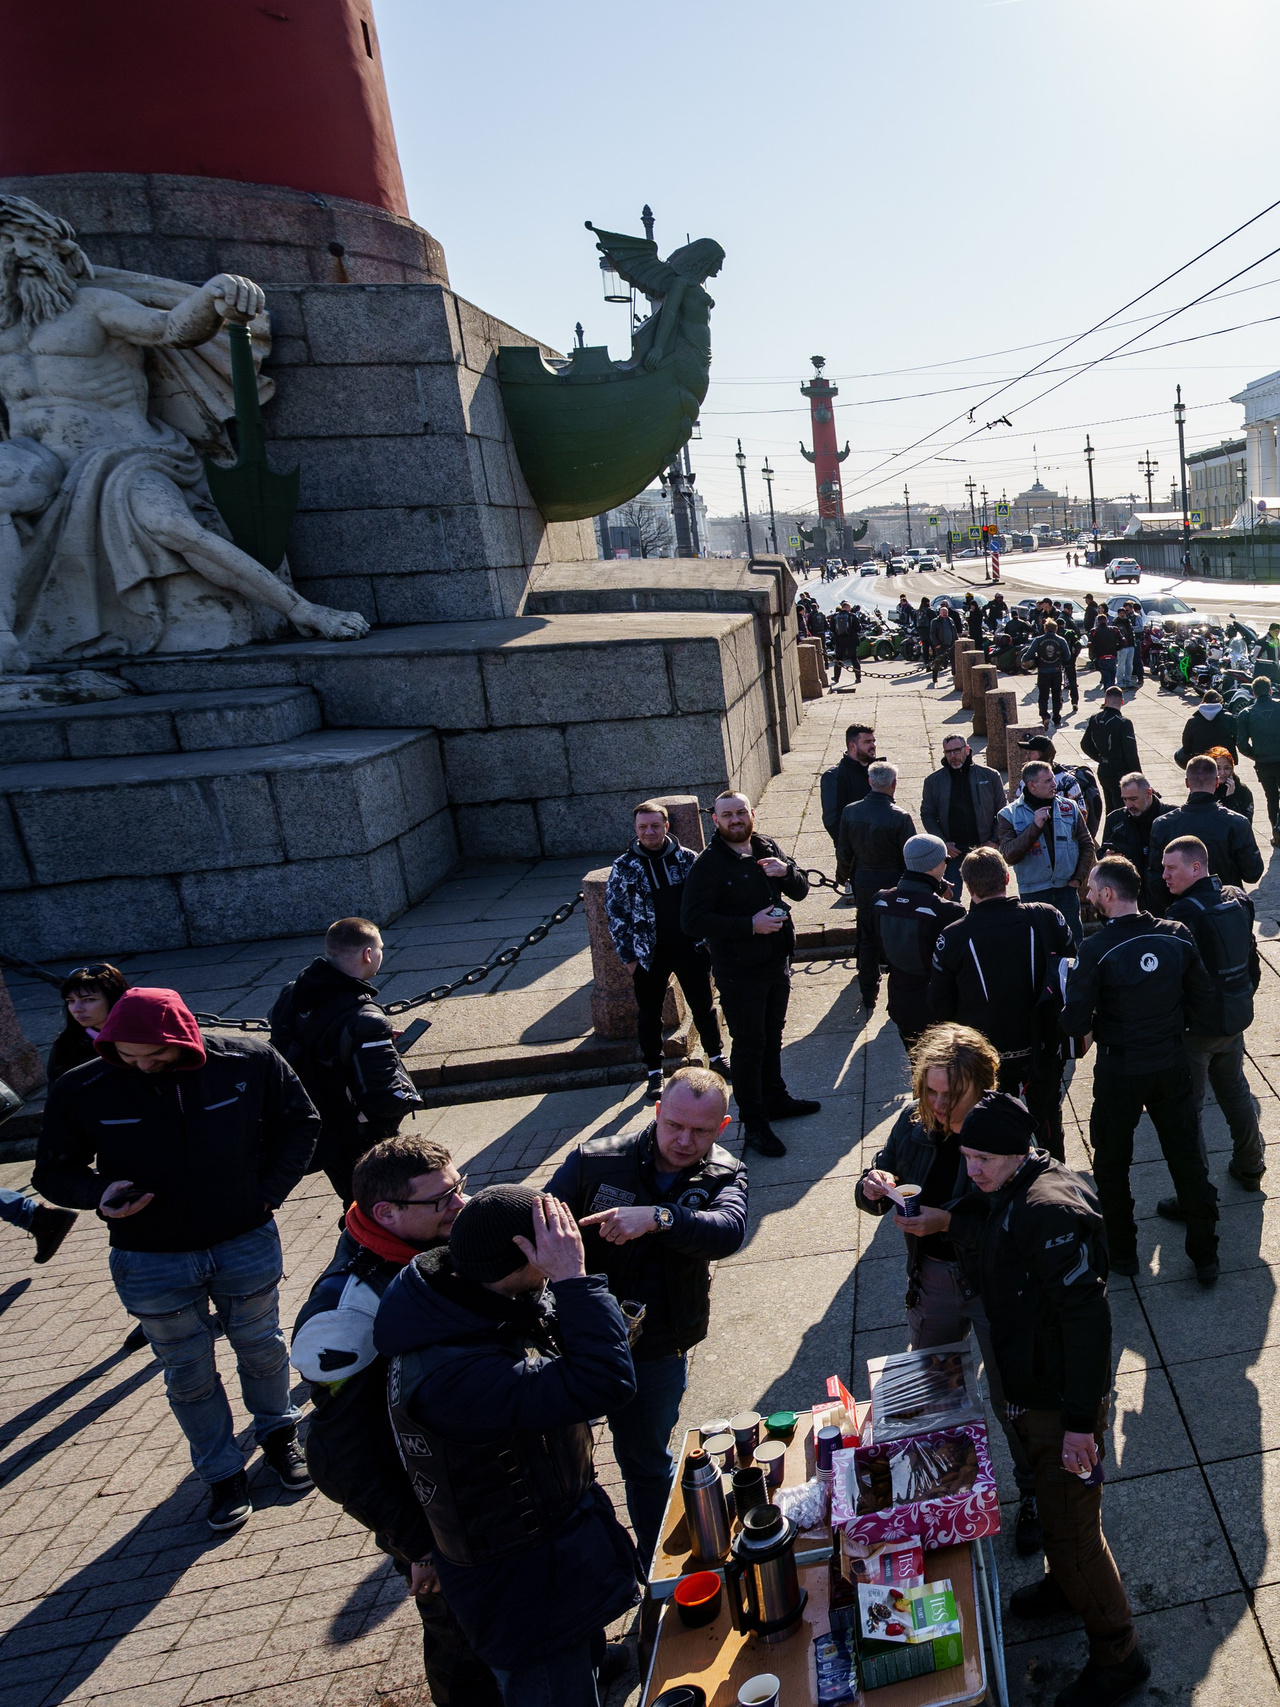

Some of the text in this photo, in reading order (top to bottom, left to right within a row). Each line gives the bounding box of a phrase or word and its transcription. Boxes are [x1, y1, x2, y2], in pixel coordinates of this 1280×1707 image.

[1045, 1232, 1075, 1249] LS2
[403, 1436, 428, 1454] MC
[897, 1550, 915, 1578] TESS
[929, 1594, 949, 1622] TESS
